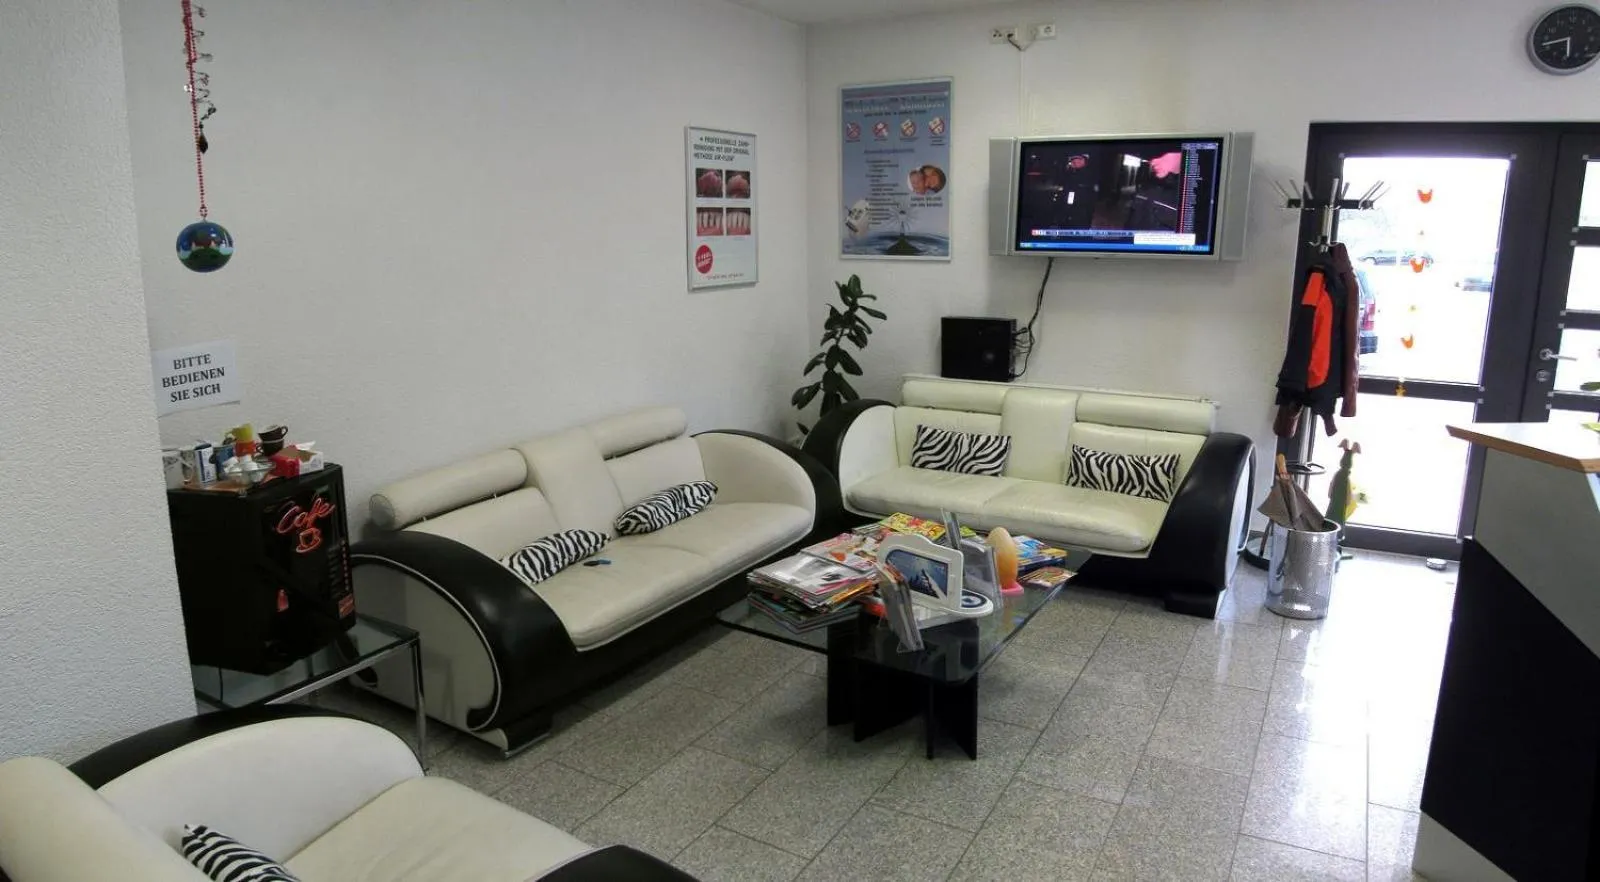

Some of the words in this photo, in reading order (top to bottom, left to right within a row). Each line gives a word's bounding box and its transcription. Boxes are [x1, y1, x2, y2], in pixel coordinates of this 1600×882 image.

[173, 353, 211, 370] BITTE
[162, 366, 225, 388] BEDIENEN
[170, 389, 191, 403] SIE
[192, 383, 221, 398] SICH
